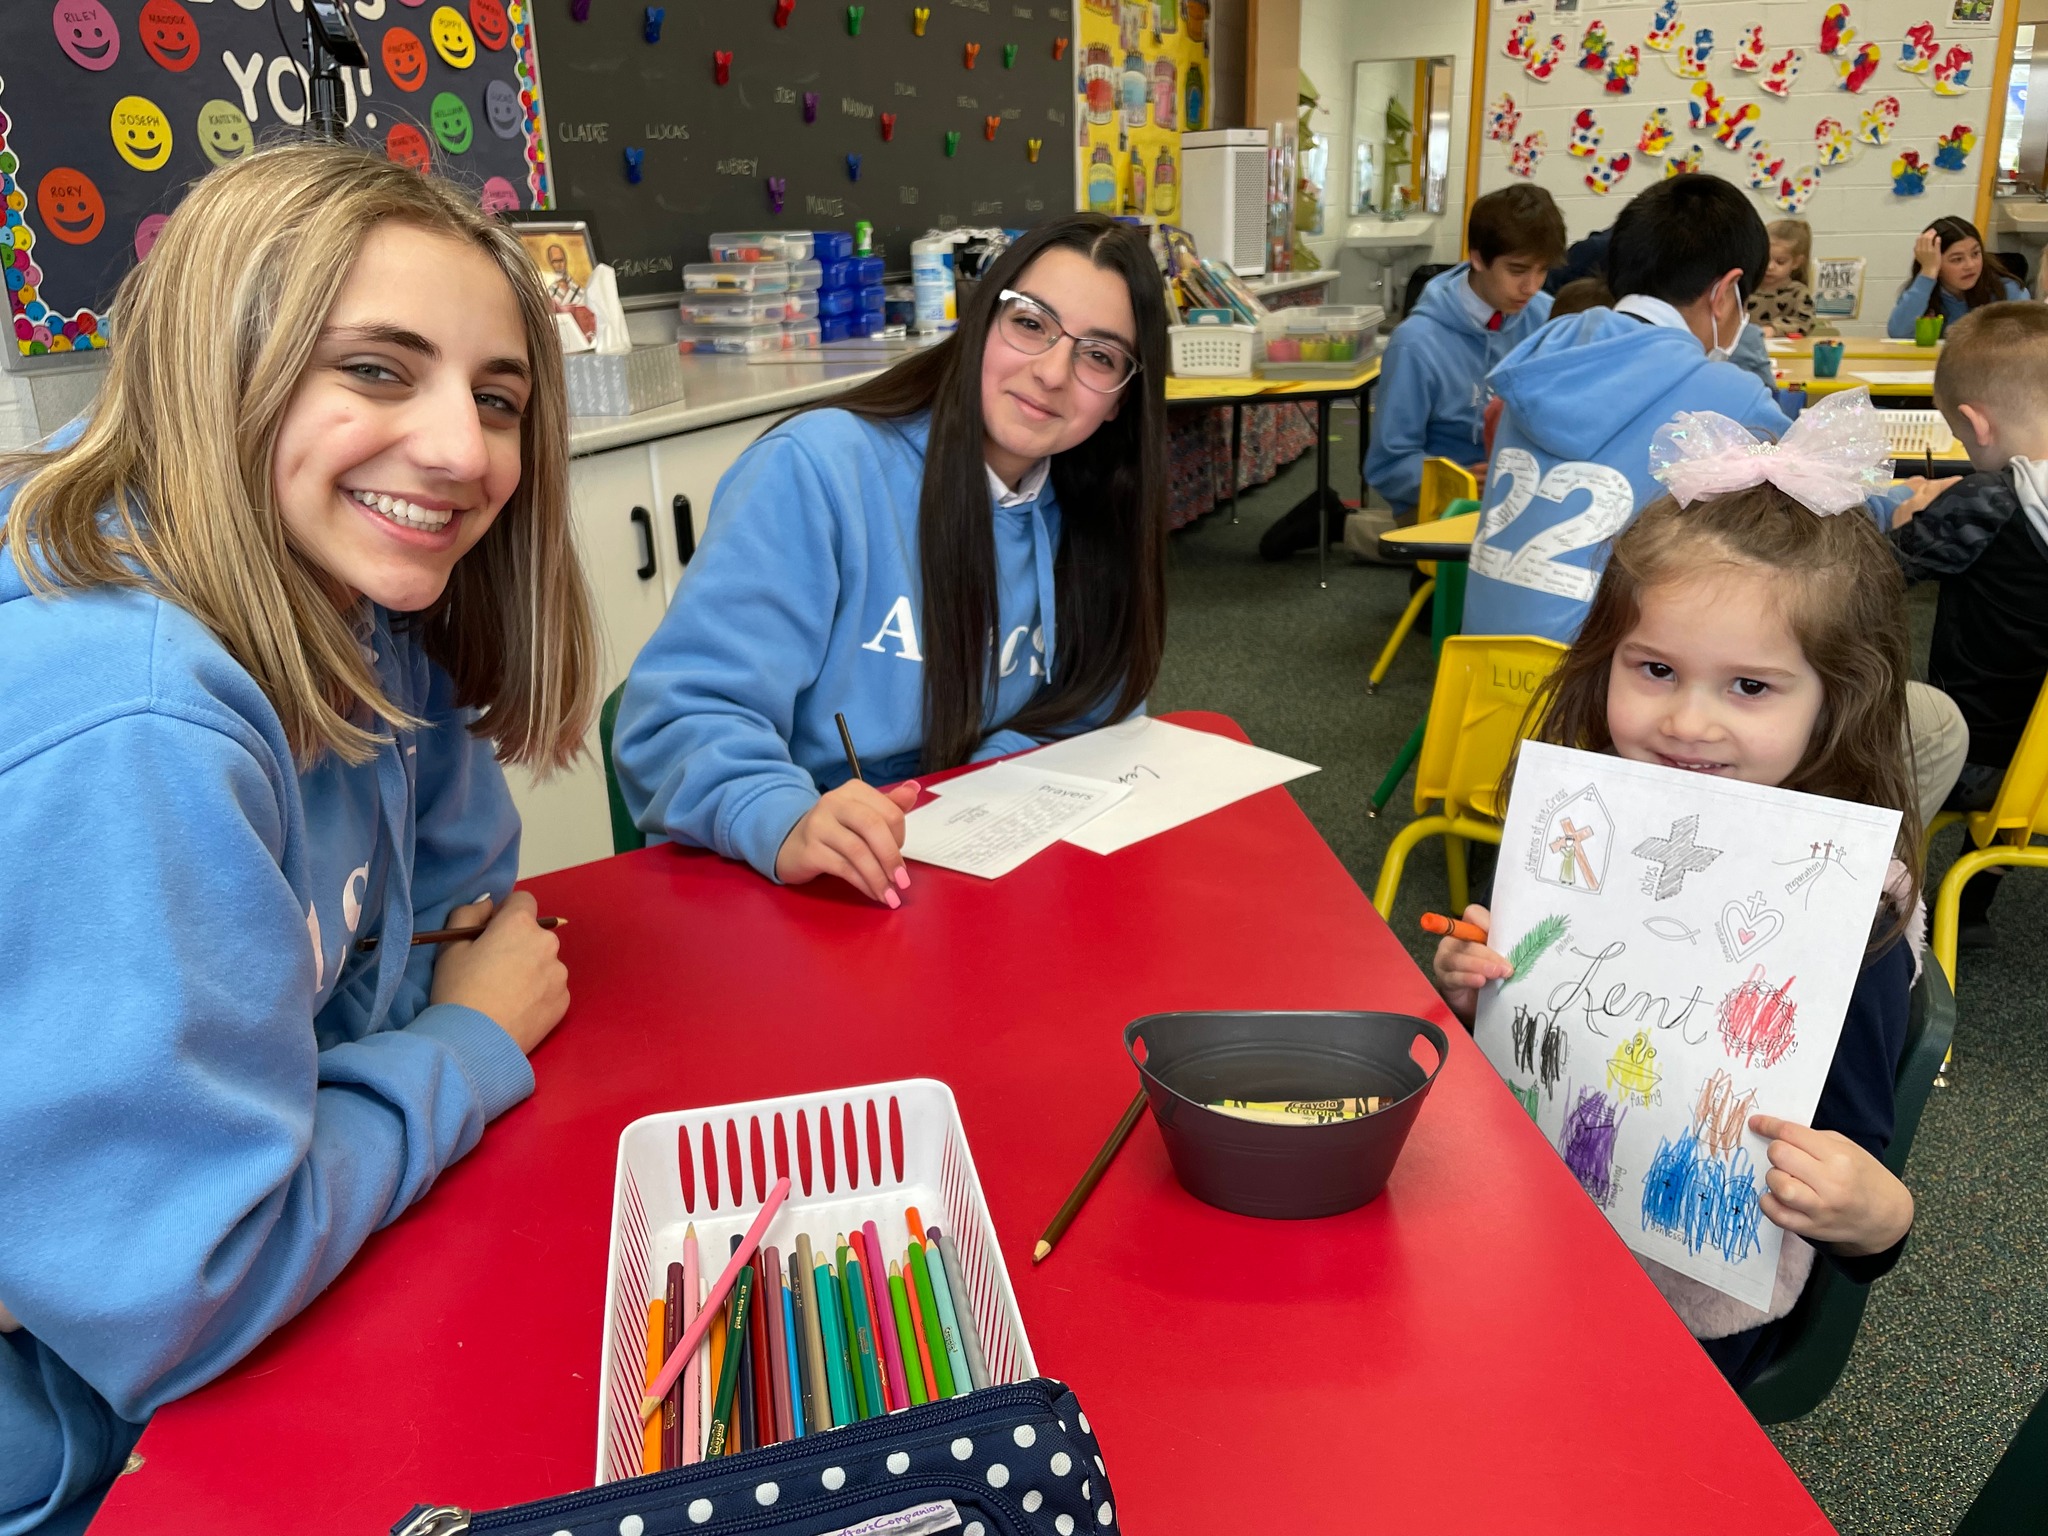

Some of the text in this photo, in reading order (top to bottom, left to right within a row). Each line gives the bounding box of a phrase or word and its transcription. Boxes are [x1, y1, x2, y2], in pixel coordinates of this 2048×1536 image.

[64, 10, 97, 23] RILEY
[119, 113, 160, 127] JOSEPH
[558, 122, 610, 144] CLAIRE
[645, 124, 690, 141] LUCAS
[50, 184, 82, 198] RORY
[610, 256, 674, 277] GRAYSON
[1469, 447, 1635, 603] 22
[1493, 663, 1536, 694] LUC
[1547, 941, 1714, 1045] Lent
[1292, 1100, 1337, 1110] Crayola
[1630, 1088, 1663, 1108] fasting
[873, 1503, 945, 1529] Companion
